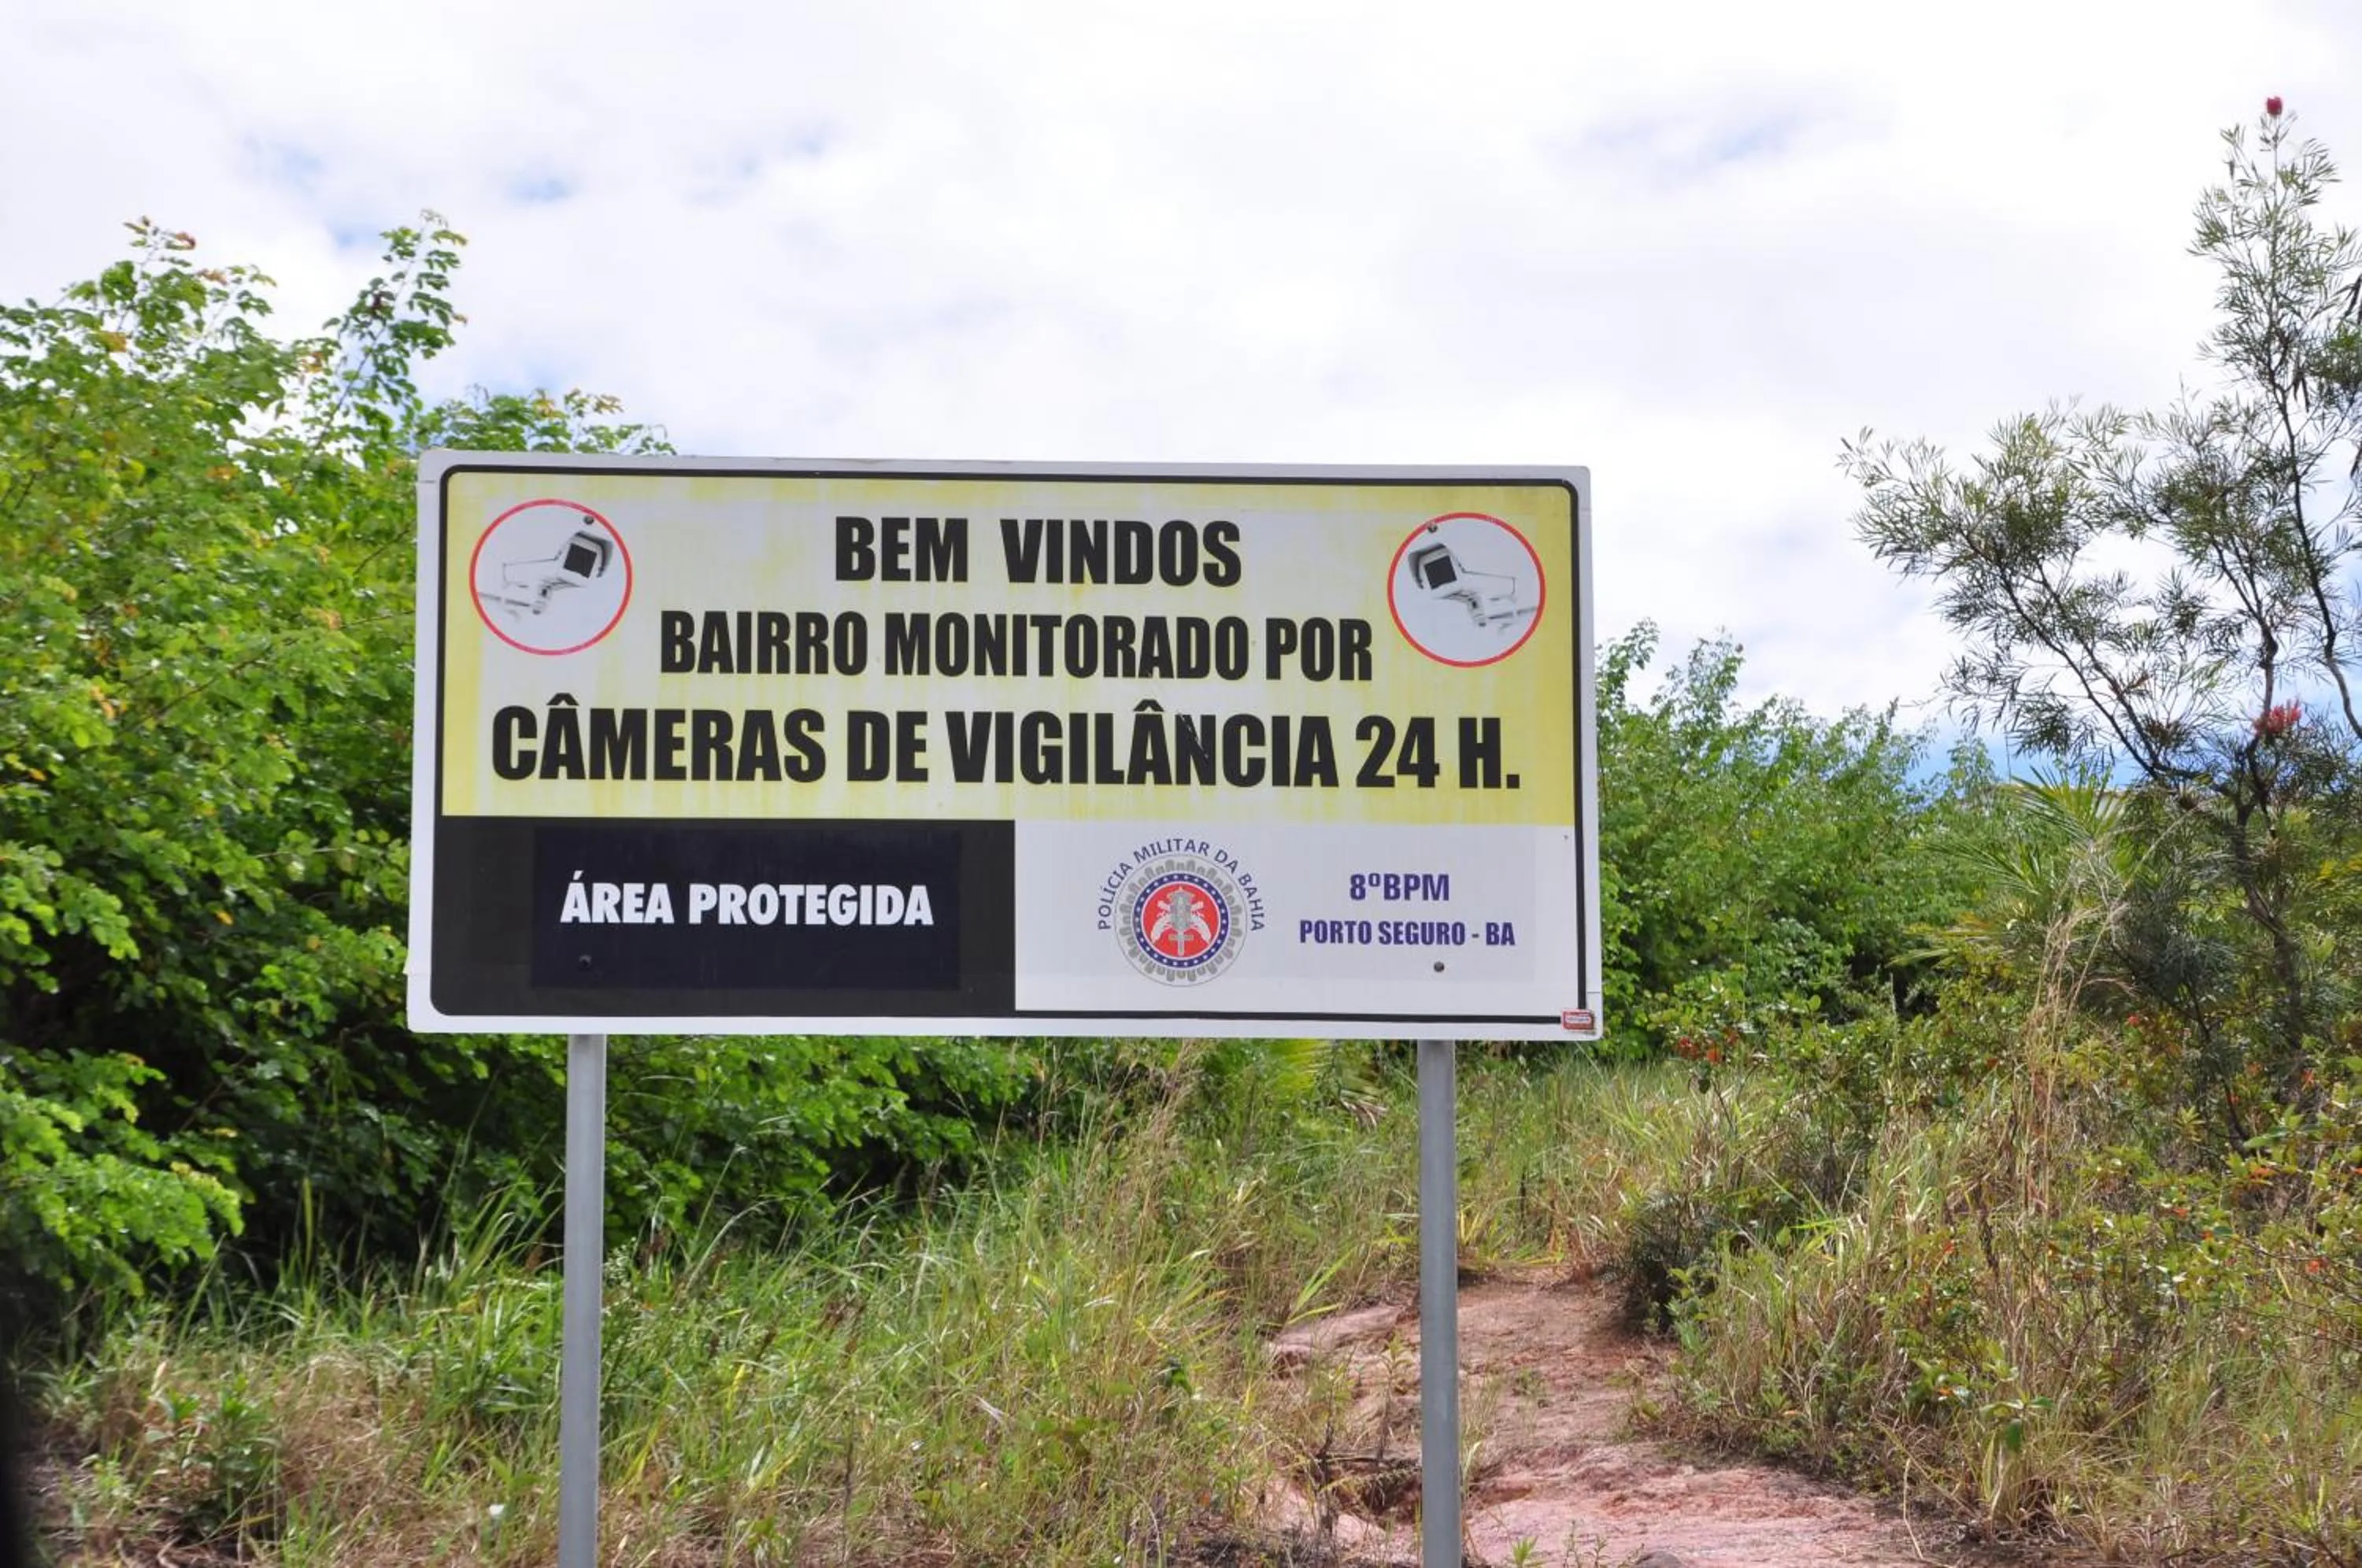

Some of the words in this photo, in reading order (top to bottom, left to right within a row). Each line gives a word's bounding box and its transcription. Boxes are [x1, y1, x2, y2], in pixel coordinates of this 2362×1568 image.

[835, 516, 968, 582] BEM
[1000, 520, 1241, 587] VINDOS
[661, 610, 867, 675] BAIRRO
[885, 612, 1249, 680] MONITORADO
[1265, 618, 1372, 681] POR
[492, 693, 826, 782] CÂMERAS
[846, 711, 928, 782] DE
[946, 699, 1339, 786] VIGILÂNCIA
[1355, 716, 1439, 788] 24
[1458, 717, 1520, 790] H.
[560, 870, 674, 925] ÁREA
[689, 884, 934, 926] PROTEGIDA
[1098, 862, 1134, 930] POLÍCIA
[1133, 838, 1210, 864] MILITAR
[1214, 849, 1238, 874] DA
[1238, 873, 1265, 932] BAHIA
[1299, 920, 1372, 945] PORTO
[1379, 921, 1465, 945] SEGURO
[1486, 922, 1516, 945] BA
